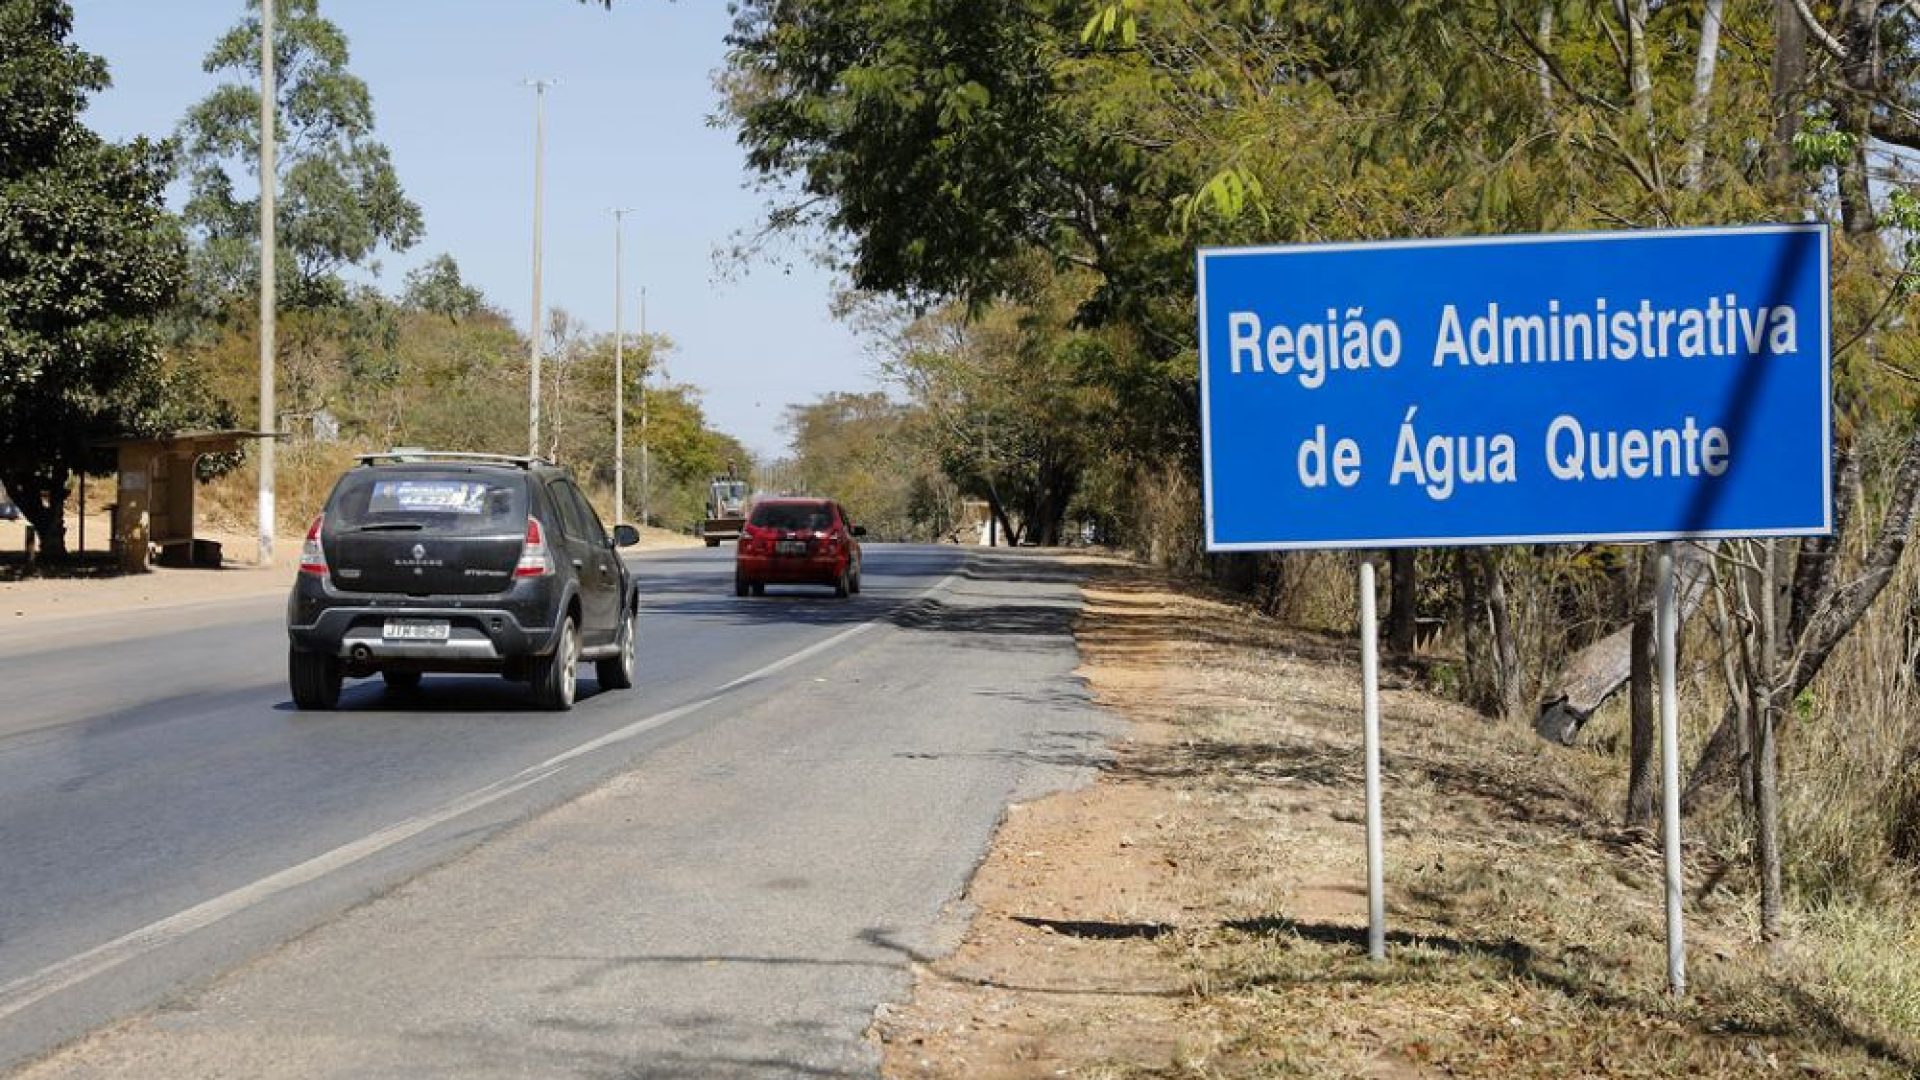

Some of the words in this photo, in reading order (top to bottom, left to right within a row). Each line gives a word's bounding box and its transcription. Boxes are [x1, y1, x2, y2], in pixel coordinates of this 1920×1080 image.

[1229, 307, 1401, 388] Região
[1433, 294, 1798, 367] Administrativa
[1298, 424, 1362, 488] de
[1390, 407, 1517, 500] Água
[1546, 416, 1729, 485] Quente
